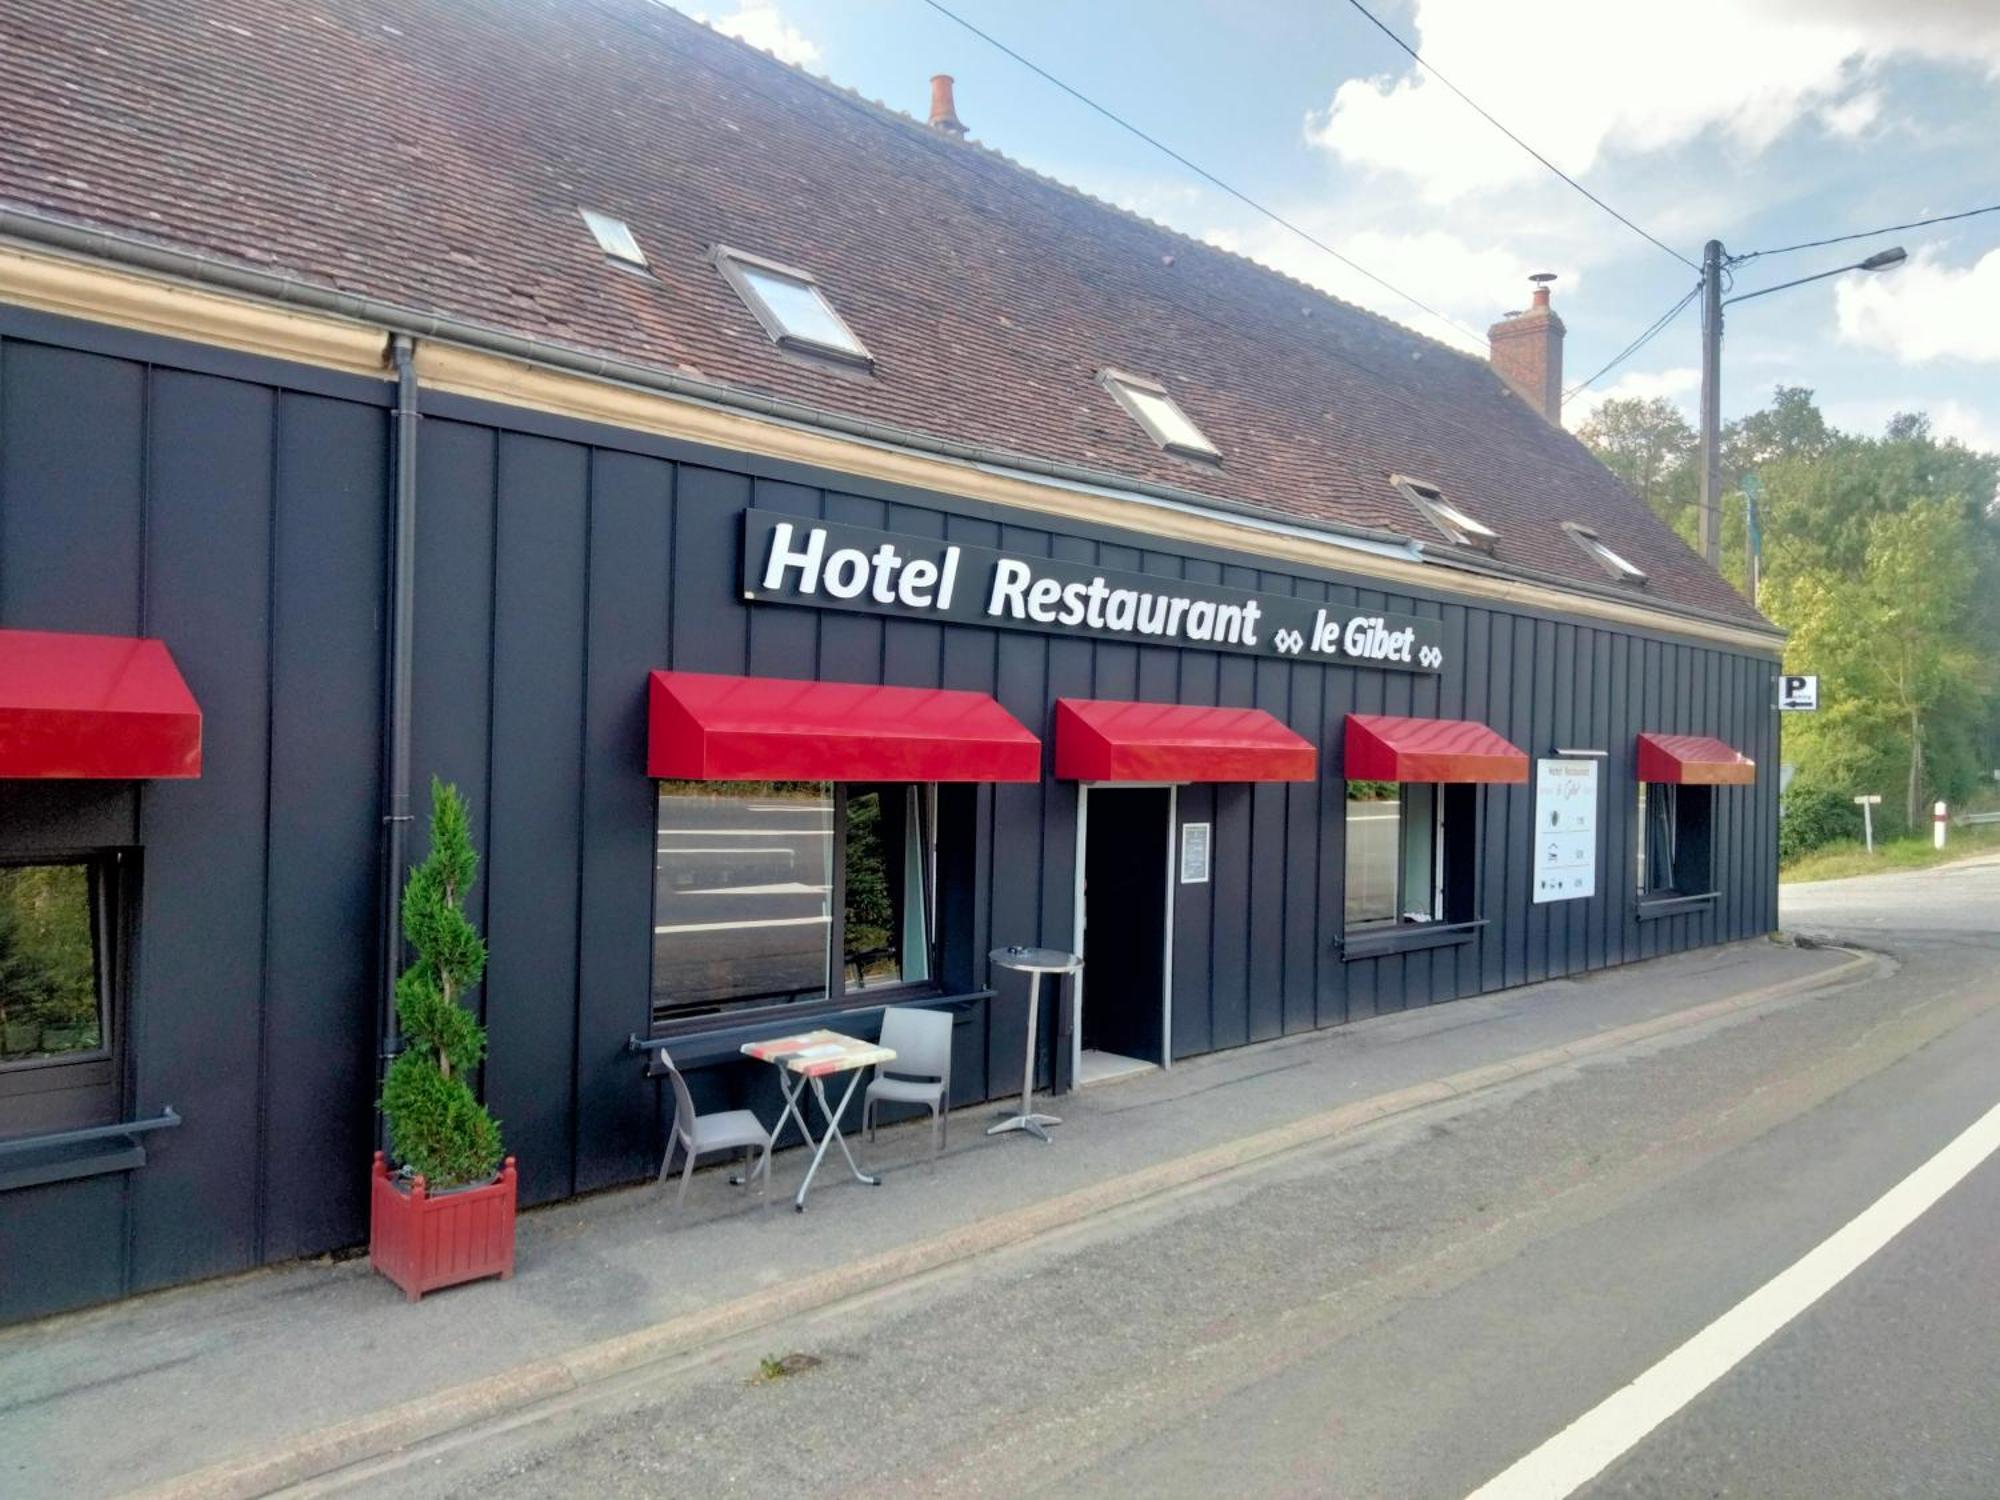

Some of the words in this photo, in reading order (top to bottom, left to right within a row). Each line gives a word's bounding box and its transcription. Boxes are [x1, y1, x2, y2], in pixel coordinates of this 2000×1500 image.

[763, 522, 961, 610] Hotel
[987, 558, 1262, 646] Restaurant
[1310, 608, 1341, 654] le
[1343, 616, 1416, 663] Gibet
